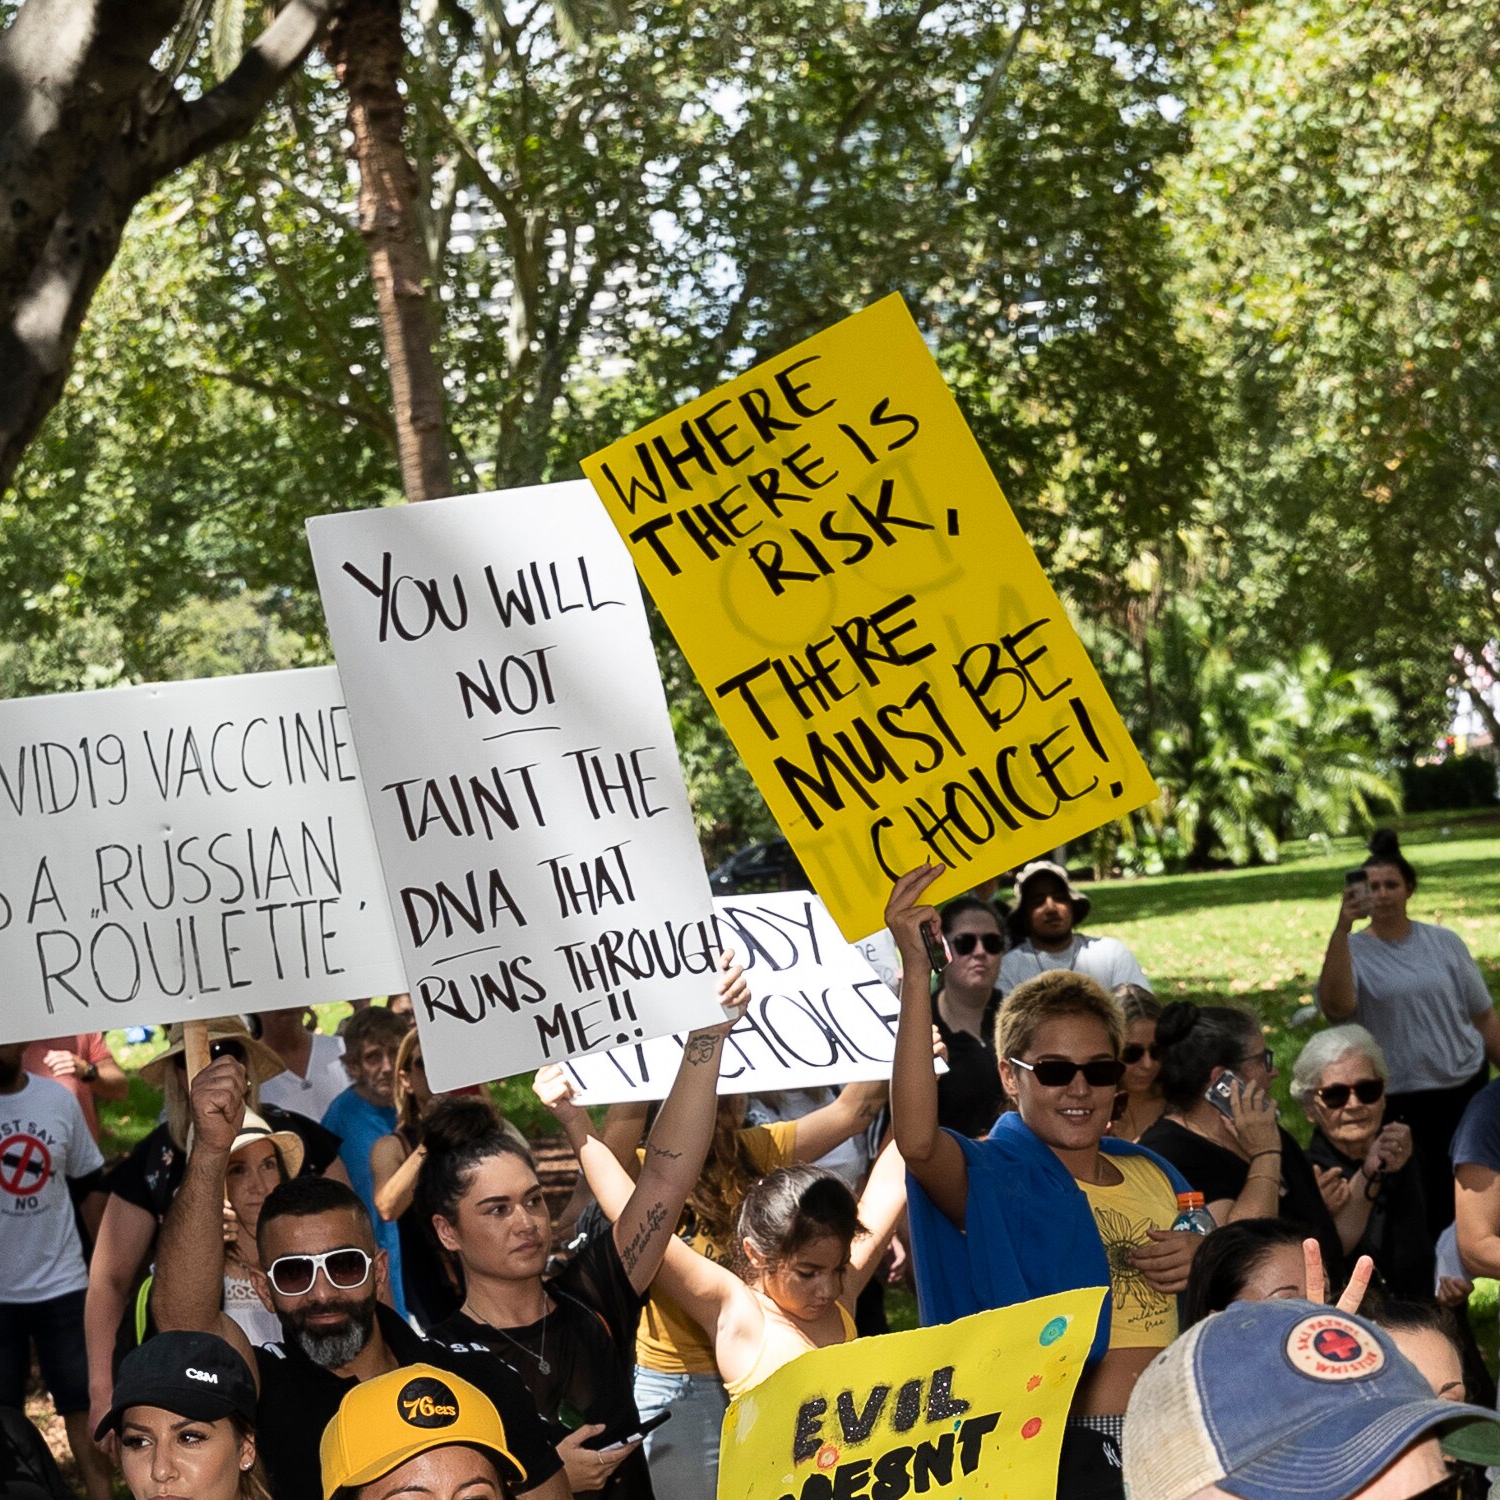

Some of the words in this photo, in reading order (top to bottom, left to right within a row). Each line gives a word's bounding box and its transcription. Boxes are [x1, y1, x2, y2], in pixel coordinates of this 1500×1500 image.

[599, 355, 837, 515] WHERE
[629, 442, 839, 576] THERE
[838, 397, 920, 464] IS
[748, 478, 959, 597] RISK,
[342, 552, 468, 643] YOU
[484, 556, 626, 628] WILL
[456, 645, 558, 719] NOT
[716, 594, 937, 741] THERE
[143, 705, 357, 801] VACCINE
[774, 683, 966, 830] MUST
[952, 617, 1073, 732] BE
[381, 762, 546, 842] TAINT
[563, 747, 670, 819] THE
[871, 696, 1124, 882] CHOICE!
[27, 855, 67, 925] A
[399, 869, 527, 948] DNA
[537, 841, 637, 919] THAT
[417, 956, 547, 1024] RUNS
[555, 914, 723, 994] THROUGH
[536, 989, 645, 1059] ME!!
[28, 1122, 56, 1146] SAY
[16, 1196, 38, 1210] NO
[185, 1367, 218, 1385] C&M
[403, 1396, 456, 1421] 76ers
[793, 1365, 971, 1464] EVIL
